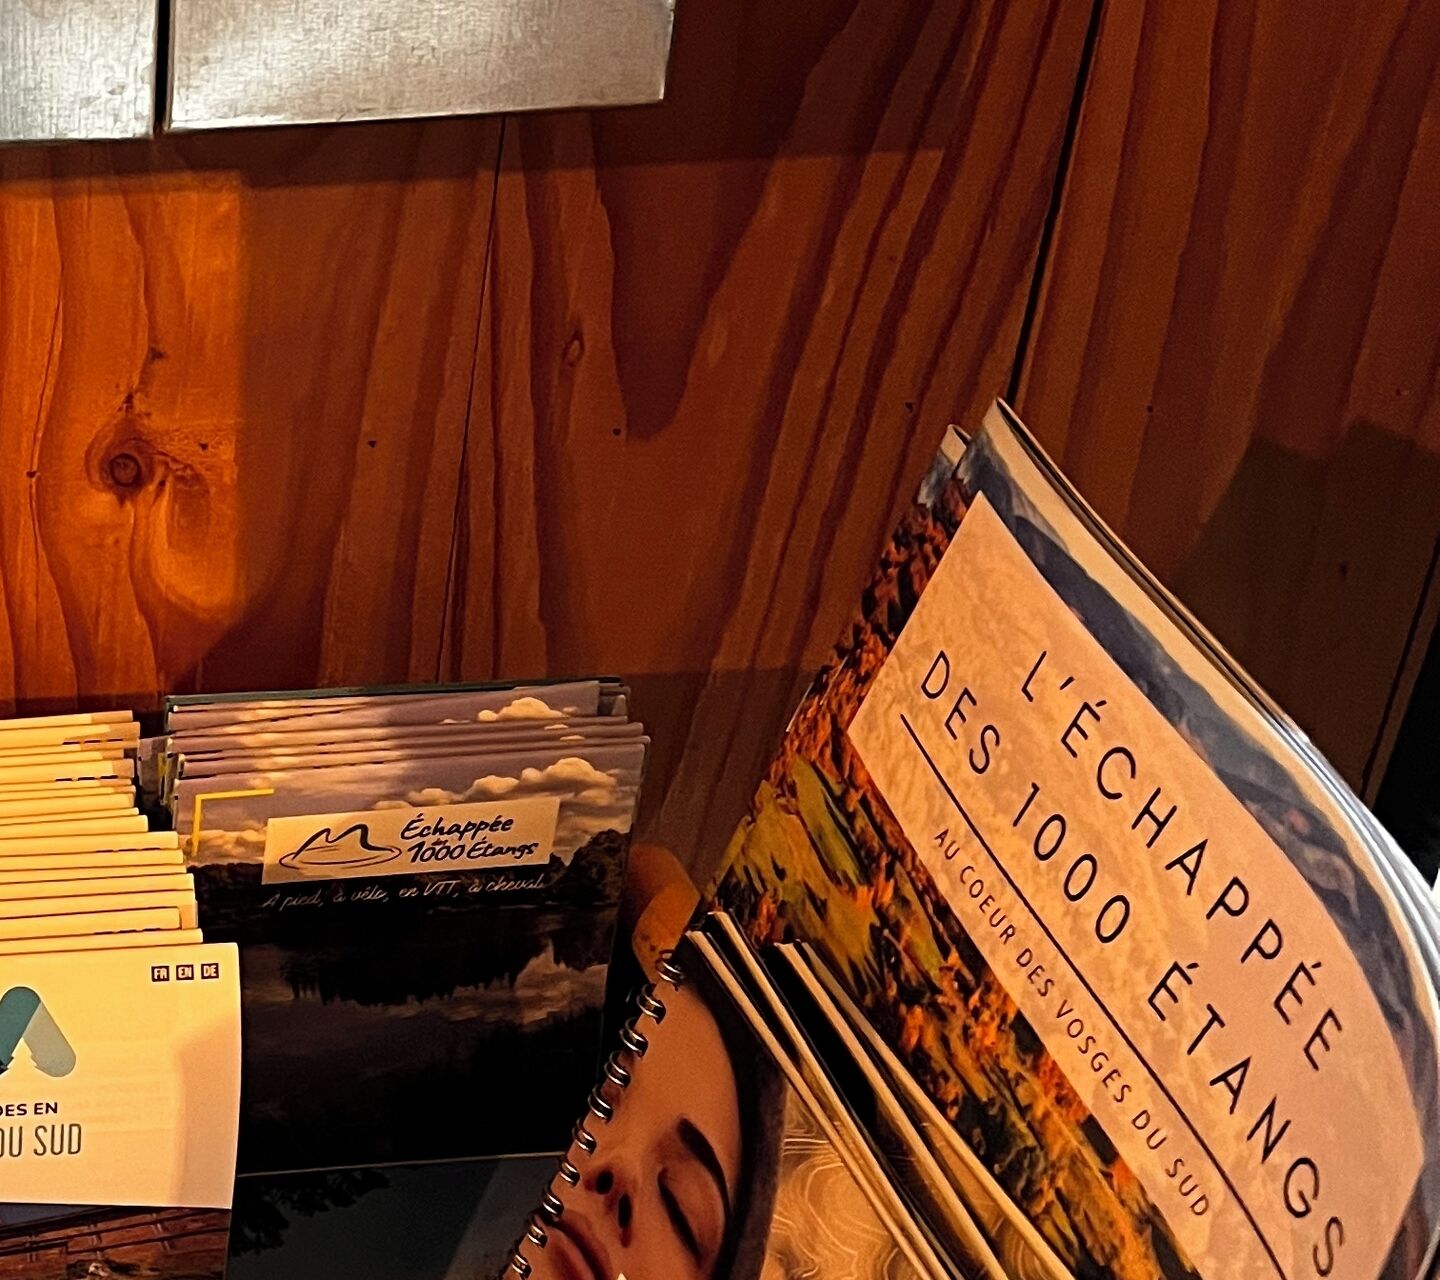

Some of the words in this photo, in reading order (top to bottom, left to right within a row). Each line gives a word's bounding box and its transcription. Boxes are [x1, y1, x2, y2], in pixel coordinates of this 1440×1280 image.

[401, 813, 514, 841] Échappée
[408, 841, 465, 863] 1000
[467, 837, 539, 859] Étangs
[1021, 650, 1342, 1071] L'ÉCHAPPÉE
[151, 965, 169, 982] FR
[176, 964, 193, 980] EN
[201, 963, 219, 978] DE
[921, 650, 1001, 775] DES
[1013, 782, 1130, 943] 1000
[1148, 961, 1344, 1277] ÉTANGS
[934, 829, 960, 860] AU
[960, 866, 1016, 944] COEUR
[1016, 948, 1054, 997] DES
[1056, 999, 1132, 1103] VOSGES
[1131, 1110, 1167, 1149] DU
[1165, 1158, 1209, 1216] SUD
[32, 1102, 59, 1116] EN
[34, 1124, 83, 1157] SUD
